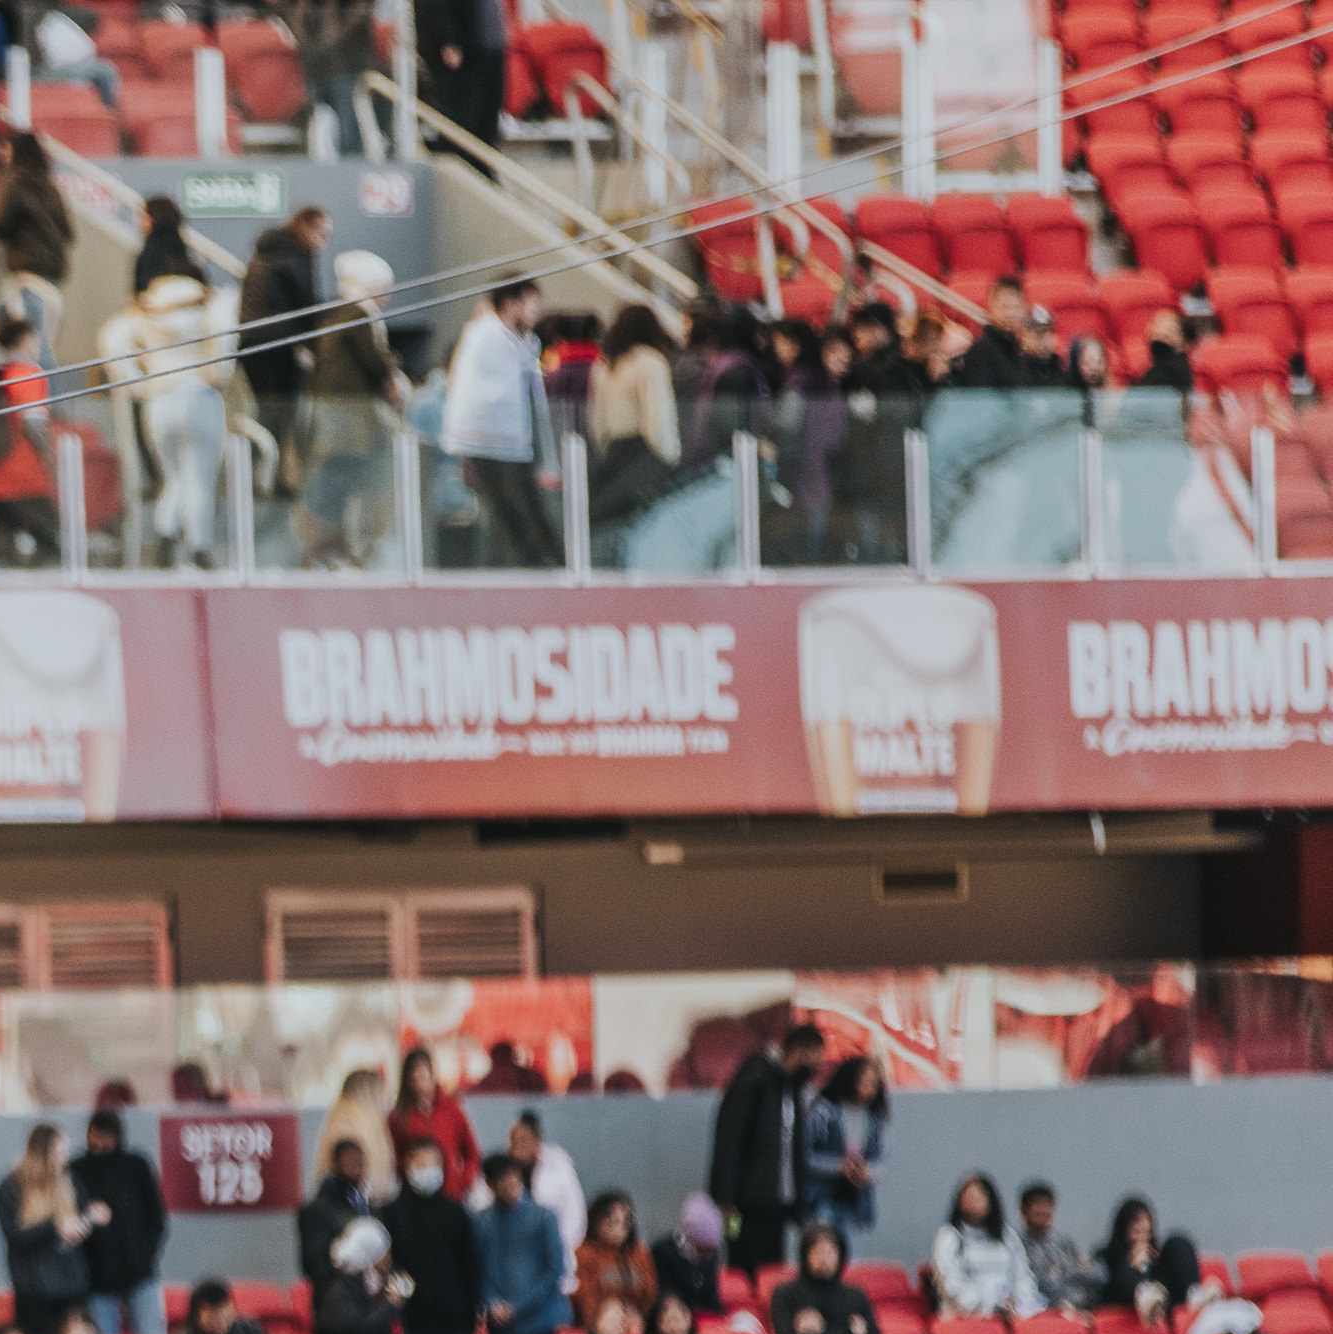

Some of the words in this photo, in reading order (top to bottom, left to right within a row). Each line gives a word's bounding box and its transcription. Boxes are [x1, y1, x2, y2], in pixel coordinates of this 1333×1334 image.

[278, 623, 739, 728] BRAHMOSIDADE
[1067, 616, 1333, 718] BRAHMO
[180, 1121, 273, 1161] SETOR
